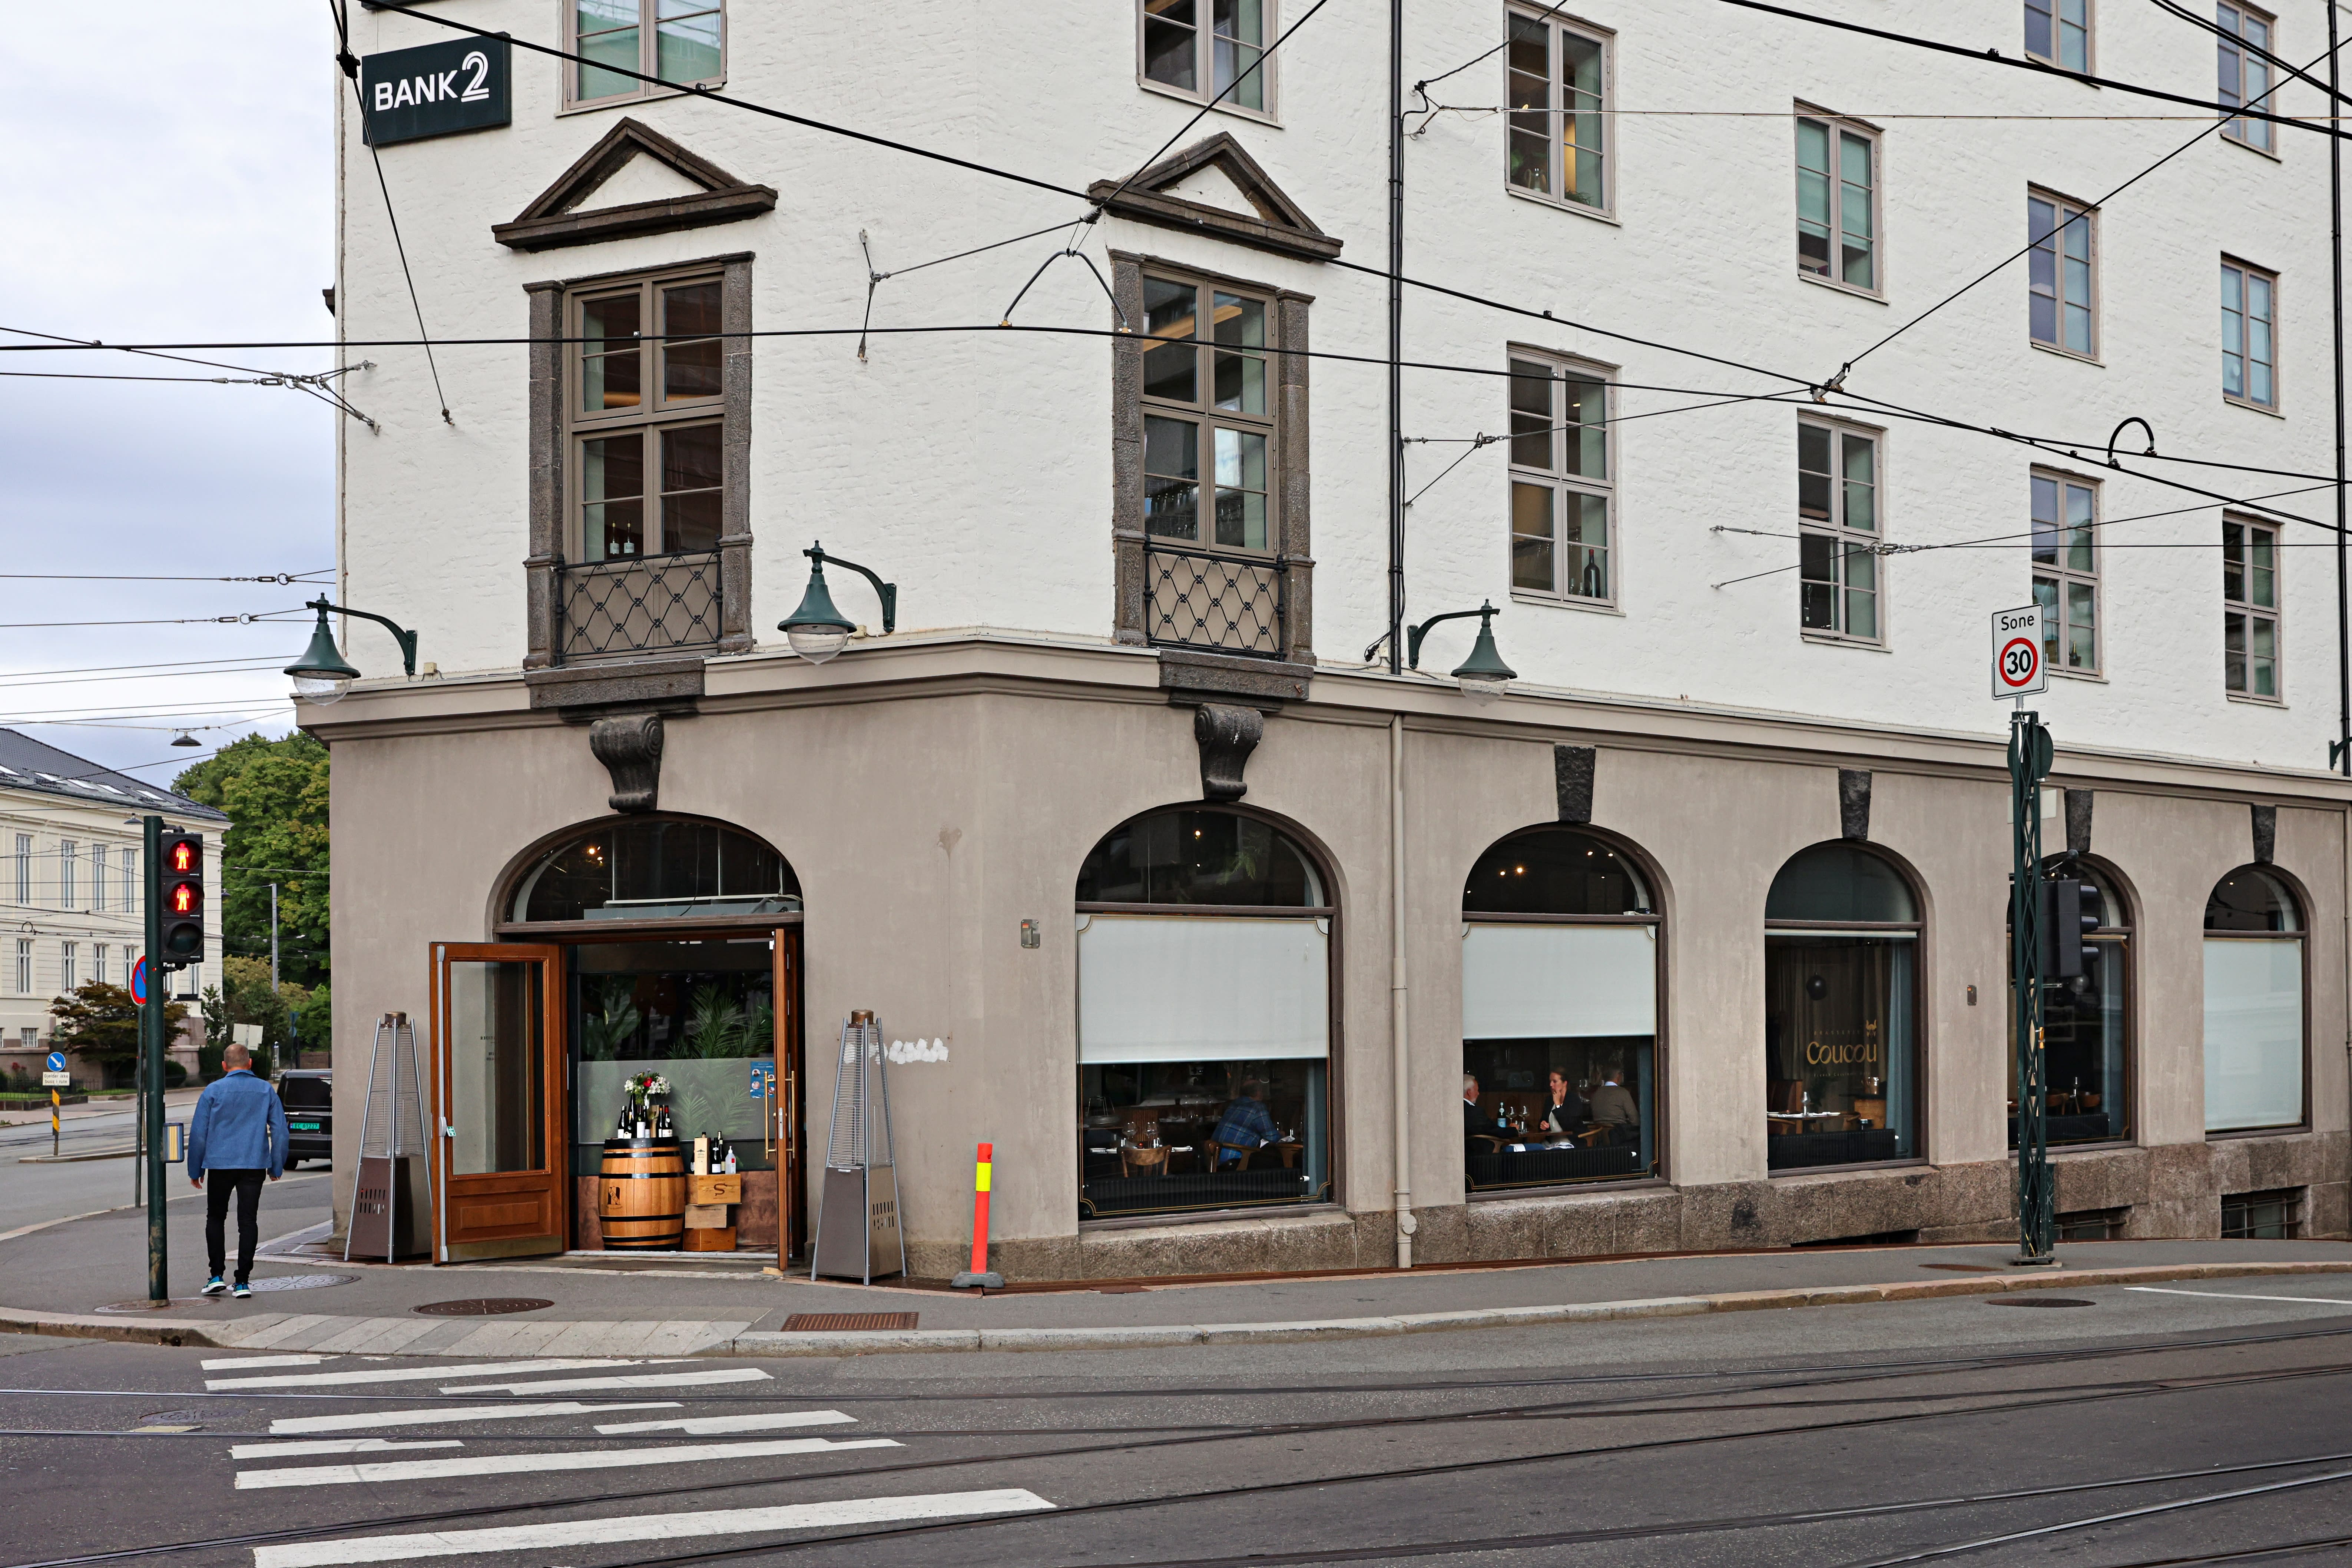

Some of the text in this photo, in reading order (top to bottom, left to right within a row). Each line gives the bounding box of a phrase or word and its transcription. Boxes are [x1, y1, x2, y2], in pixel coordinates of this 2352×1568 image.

[2001, 615, 2034, 631] Sone
[2006, 650, 2031, 674] 30
[1806, 1041, 1877, 1064] Coucou
